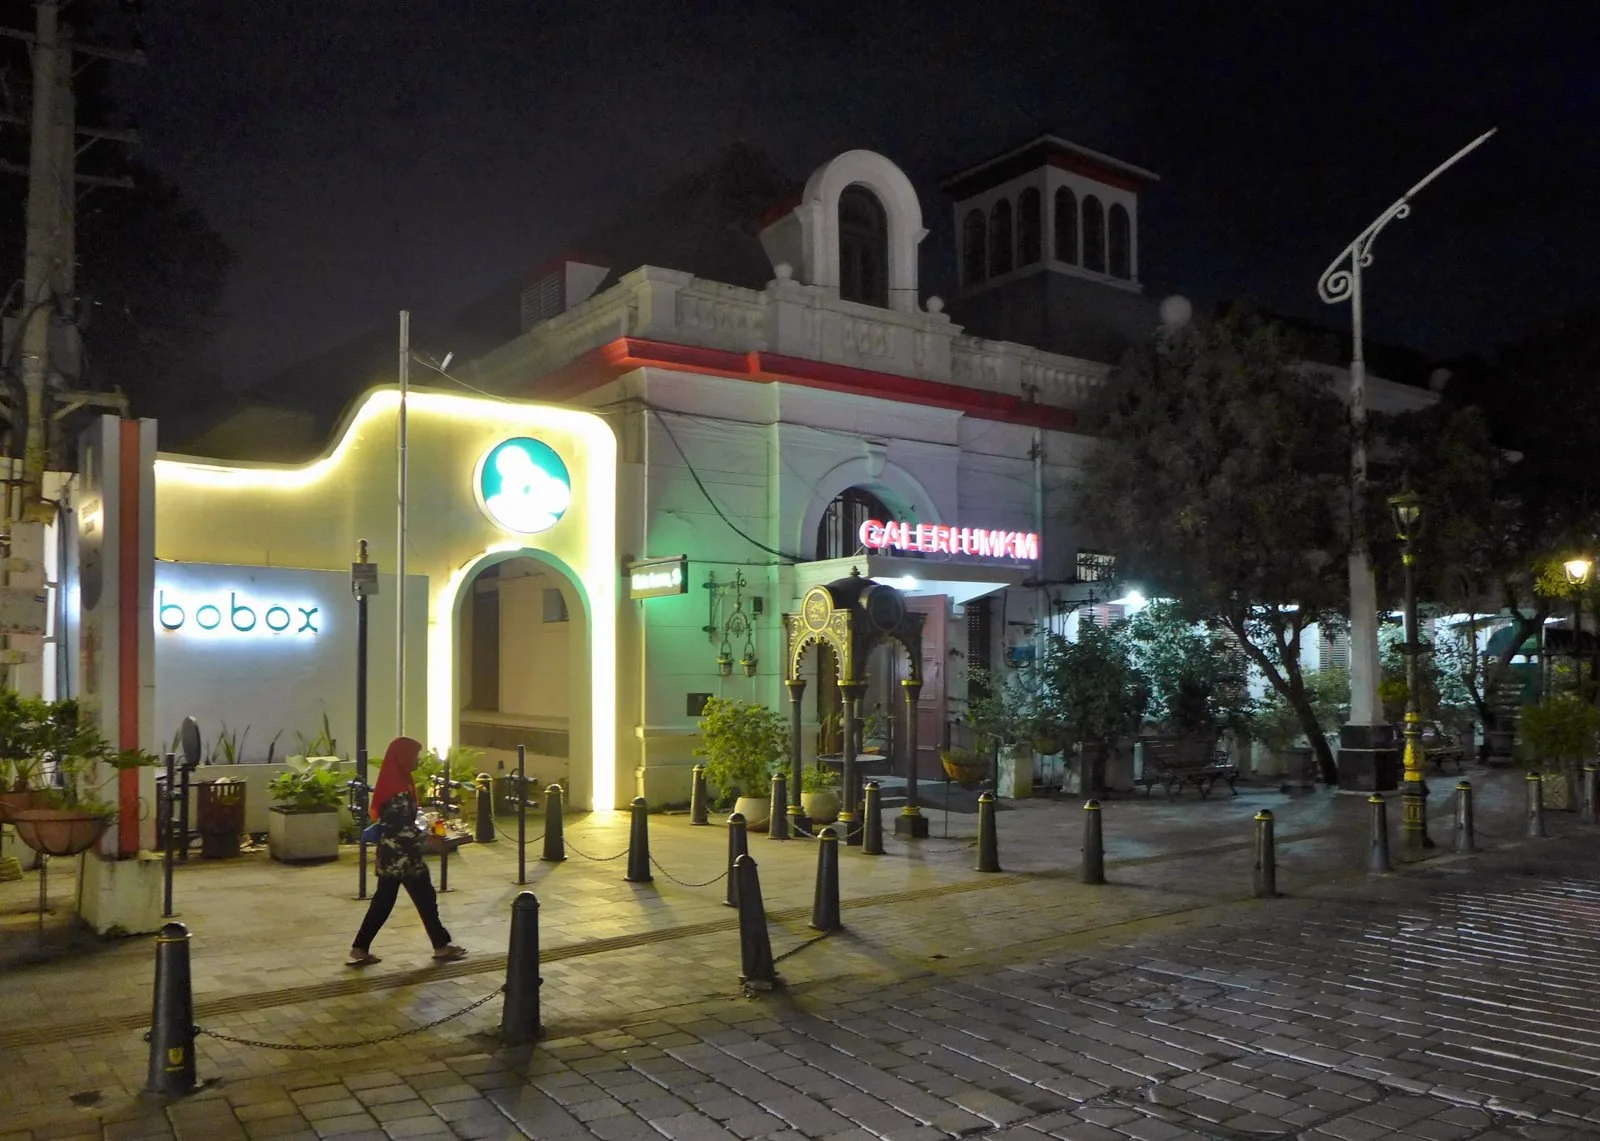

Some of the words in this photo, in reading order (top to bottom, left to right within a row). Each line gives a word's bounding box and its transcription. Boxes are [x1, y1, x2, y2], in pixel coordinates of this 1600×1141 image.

[859, 518, 961, 554] GALERI
[962, 527, 1040, 560] UMKM
[159, 590, 319, 633] bobox
